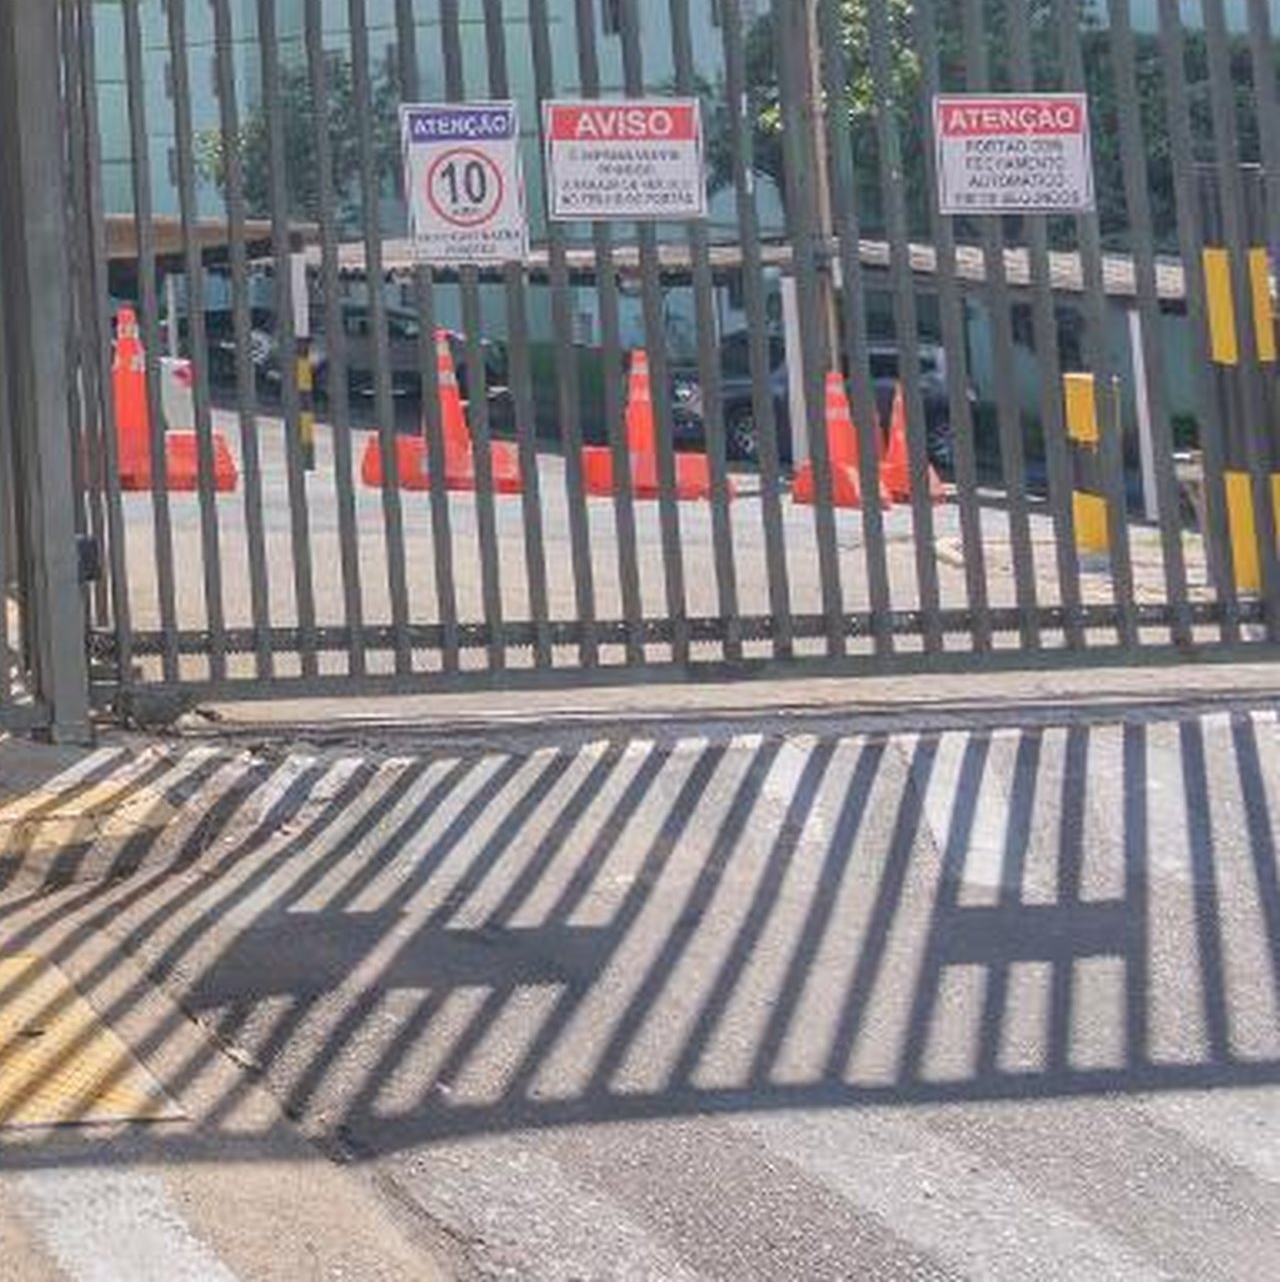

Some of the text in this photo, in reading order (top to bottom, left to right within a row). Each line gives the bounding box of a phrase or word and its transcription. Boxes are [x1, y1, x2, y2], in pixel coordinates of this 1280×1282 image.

[413, 112, 507, 136] ATENÇÃO
[575, 109, 674, 137] AVISO
[948, 102, 1074, 133] ATENÇÃO
[440, 160, 487, 205] 10
